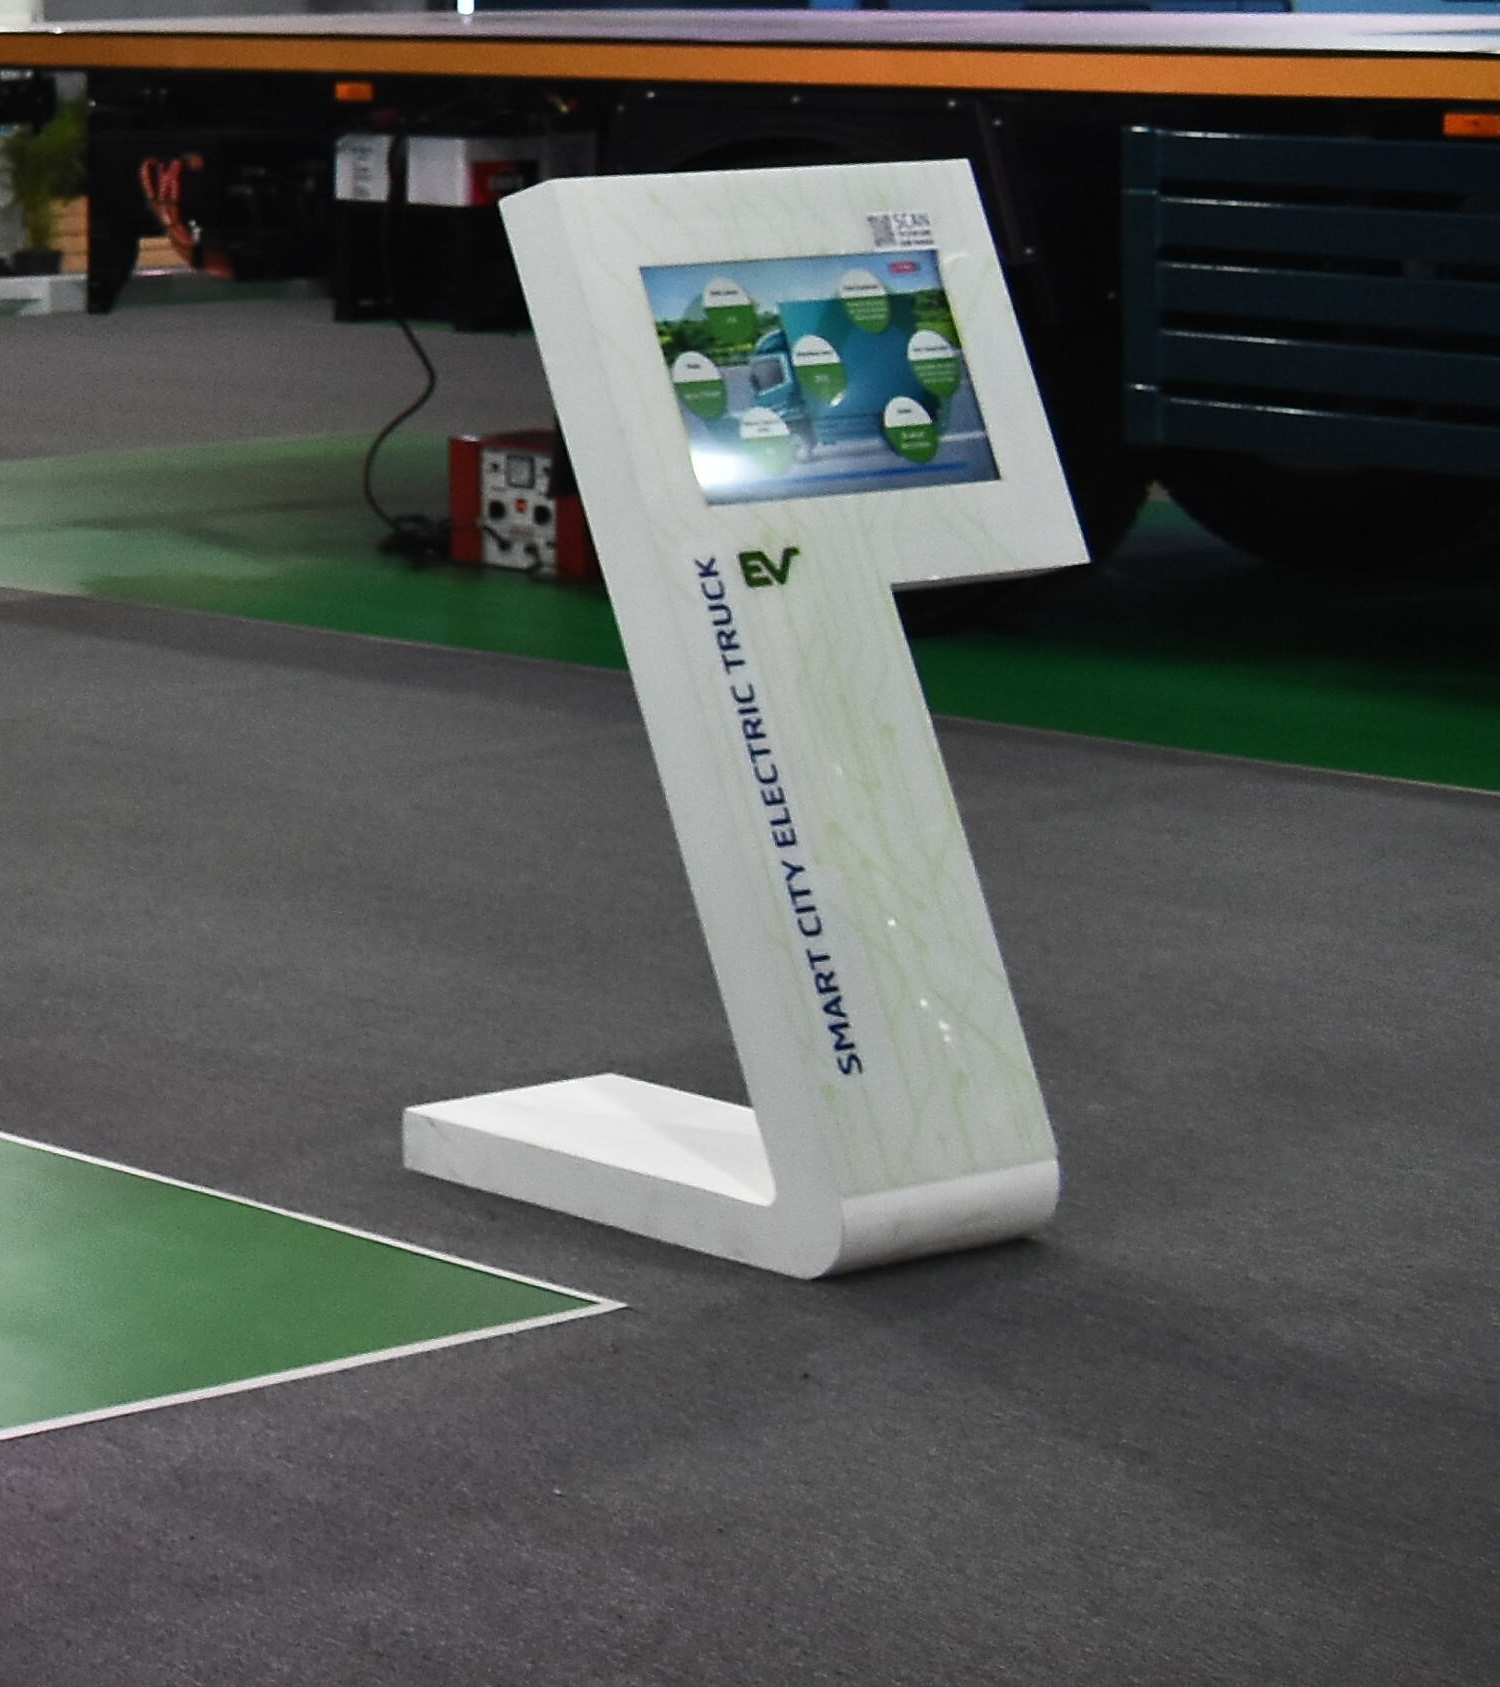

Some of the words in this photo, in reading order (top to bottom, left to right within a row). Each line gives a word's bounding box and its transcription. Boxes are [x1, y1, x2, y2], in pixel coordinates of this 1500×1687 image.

[694, 557, 747, 675] TRUCK
[739, 546, 800, 588] EV
[731, 683, 798, 848] ELECTRIC
[781, 860, 823, 938] CITY
[806, 948, 863, 1076] SMART
